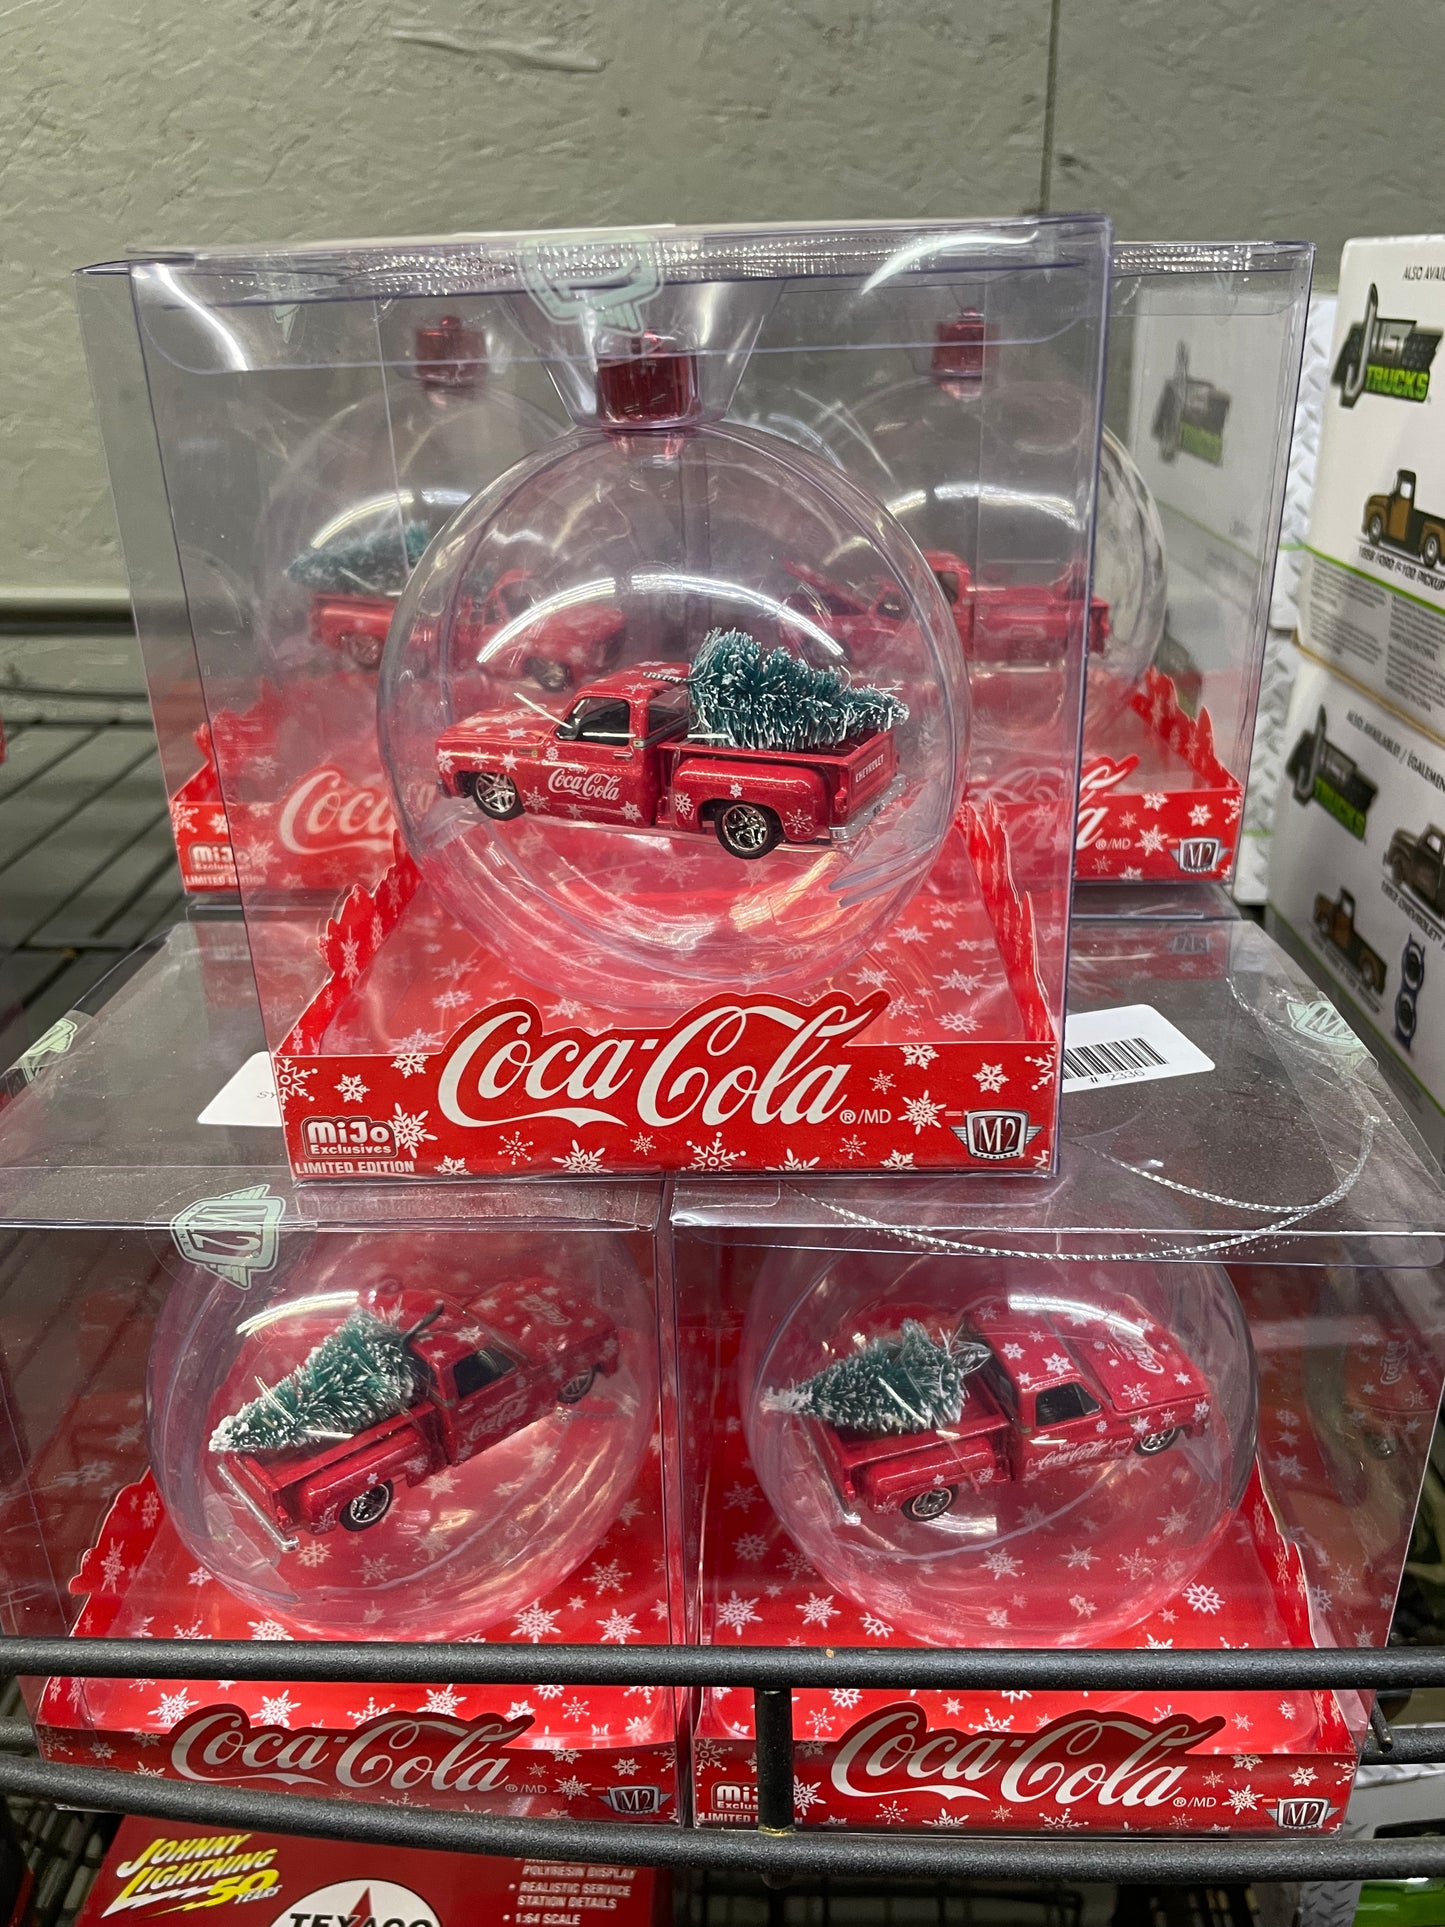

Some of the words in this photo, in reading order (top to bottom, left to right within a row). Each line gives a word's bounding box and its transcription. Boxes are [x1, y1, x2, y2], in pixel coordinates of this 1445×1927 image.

[1403, 265, 1423, 281] ALSO
[1366, 364, 1429, 401] TRUCKS
[547, 768, 622, 801] Coca-Cola
[437, 1005, 871, 1128] Coca-Cola
[978, 1117, 1017, 1153] M2
[310, 1144, 392, 1155] Exclusives
[295, 1162, 354, 1174] LIMITED
[357, 1161, 415, 1174] EDITION
[171, 1712, 525, 1792] Coca-Cola
[831, 1711, 1213, 1807] Coca-Cola
[619, 1789, 651, 1812] M2
[701, 1811, 751, 1823] LIMITED
[1288, 1802, 1320, 1825] M2
[116, 1833, 253, 1878] JOHNNY
[104, 1849, 278, 1914] LIGHTNING
[522, 1864, 586, 1877] POLYRESIN
[586, 1867, 637, 1880] DISPLAY
[207, 1868, 280, 1907] 50
[234, 1884, 283, 1905] YEARS
[519, 1881, 581, 1894] REALISTIC
[581, 1883, 632, 1896] SERVICE
[517, 1894, 568, 1907] STATION
[567, 1896, 618, 1909] DETAILS
[515, 1912, 542, 1924] 1:64
[541, 1913, 582, 1925] SCALE
